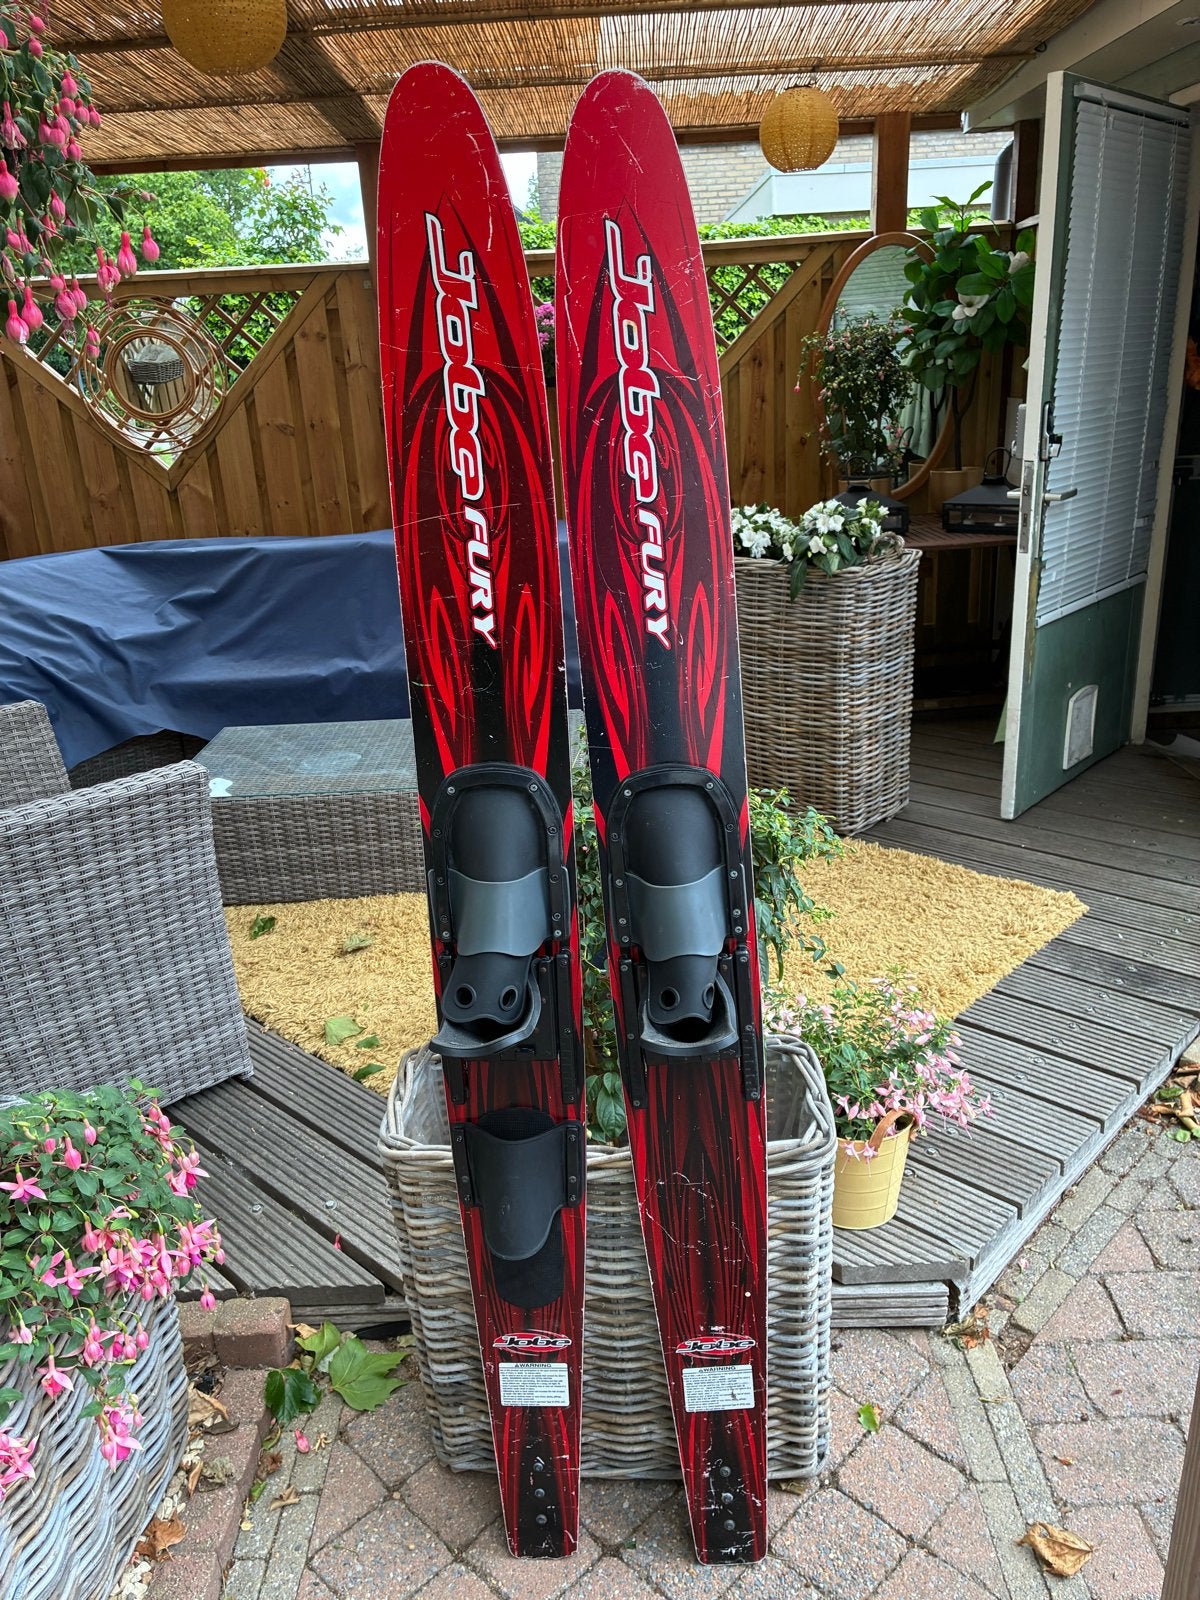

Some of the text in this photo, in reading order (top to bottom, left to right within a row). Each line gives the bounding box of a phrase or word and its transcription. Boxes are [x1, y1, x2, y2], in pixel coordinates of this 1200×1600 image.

[425, 212, 497, 650] Jobe FURY
[604, 217, 671, 650] Jobe FURY
[493, 1335, 572, 1348] Jobe
[676, 1339, 756, 1354] Jobe
